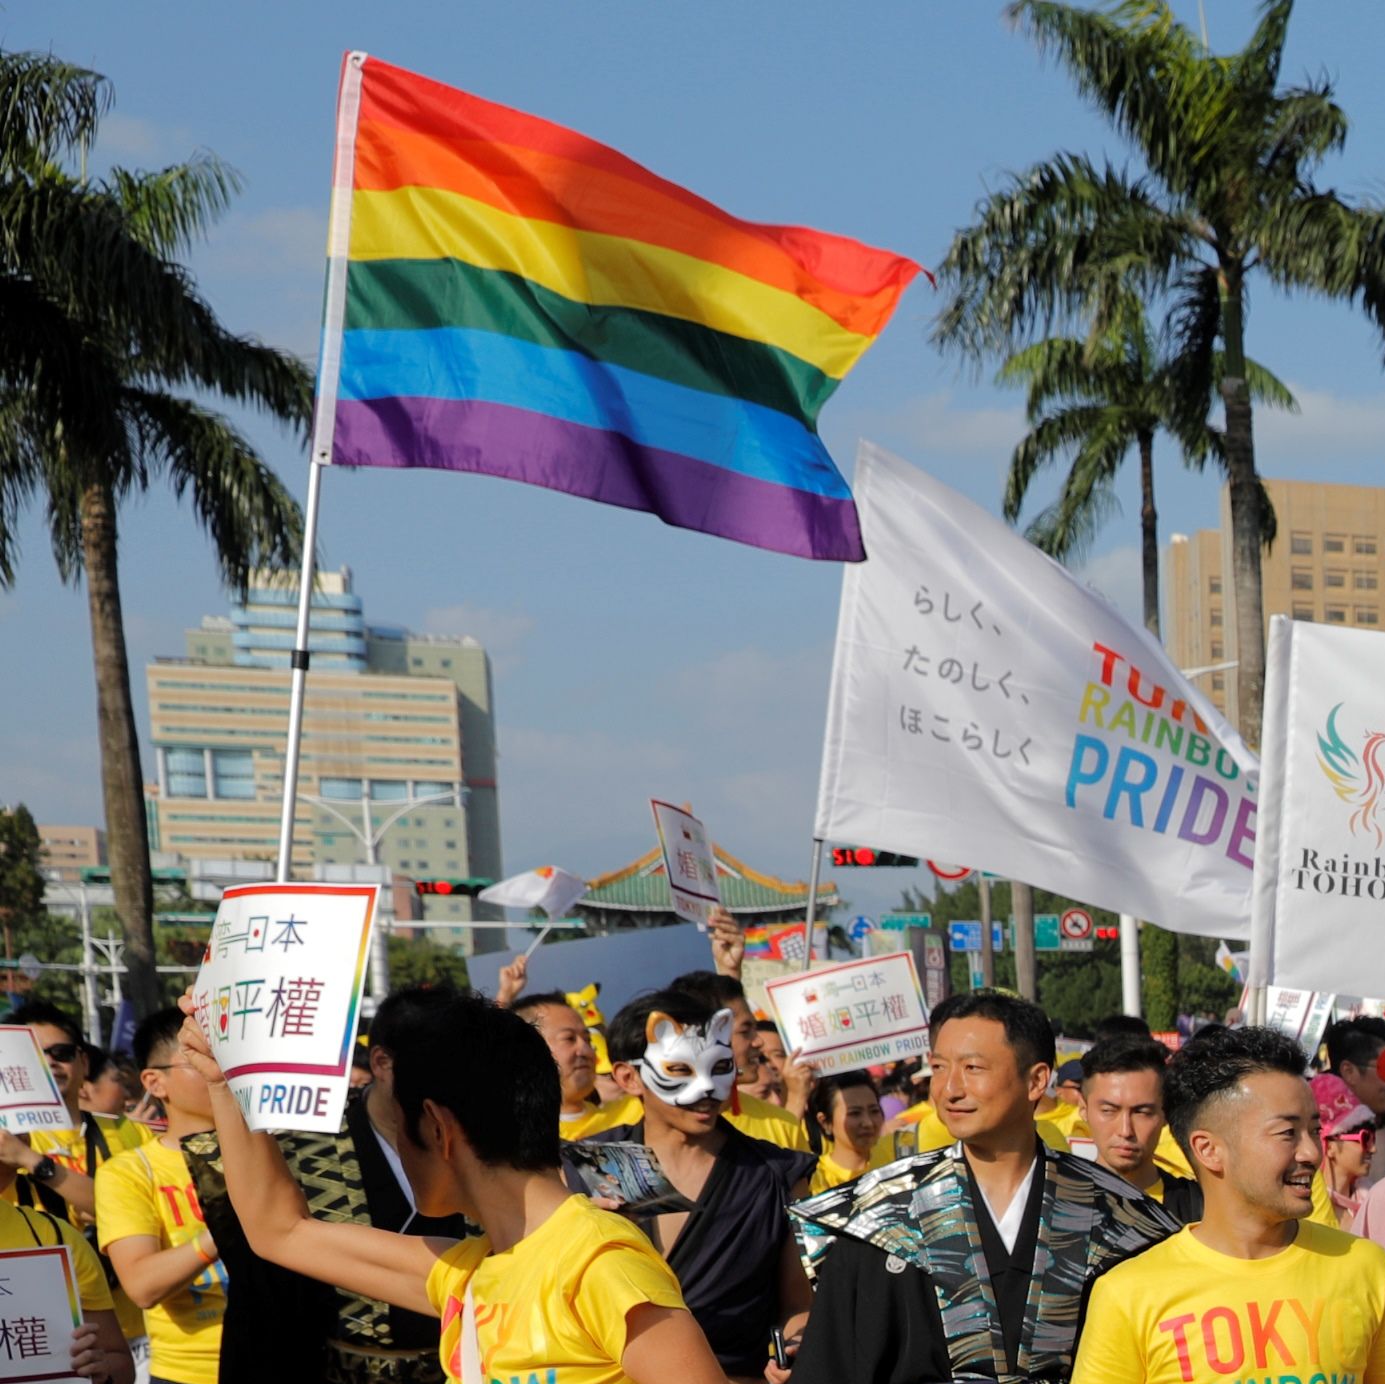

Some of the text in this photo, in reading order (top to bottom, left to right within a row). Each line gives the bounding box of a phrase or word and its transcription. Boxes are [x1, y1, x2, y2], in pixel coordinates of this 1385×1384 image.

[913, 585, 1003, 637] らしく、
[902, 644, 1031, 705] たのしく、
[899, 704, 1033, 766] ほこらしく
[1078, 680, 1256, 793] RAINBO
[1065, 733, 1259, 872] PRIDE
[840, 1043, 891, 1065] RAINBOW
[895, 1034, 930, 1053] PRIDE
[16, 1110, 64, 1126] PRIDE
[258, 1084, 331, 1117] PRIDE
